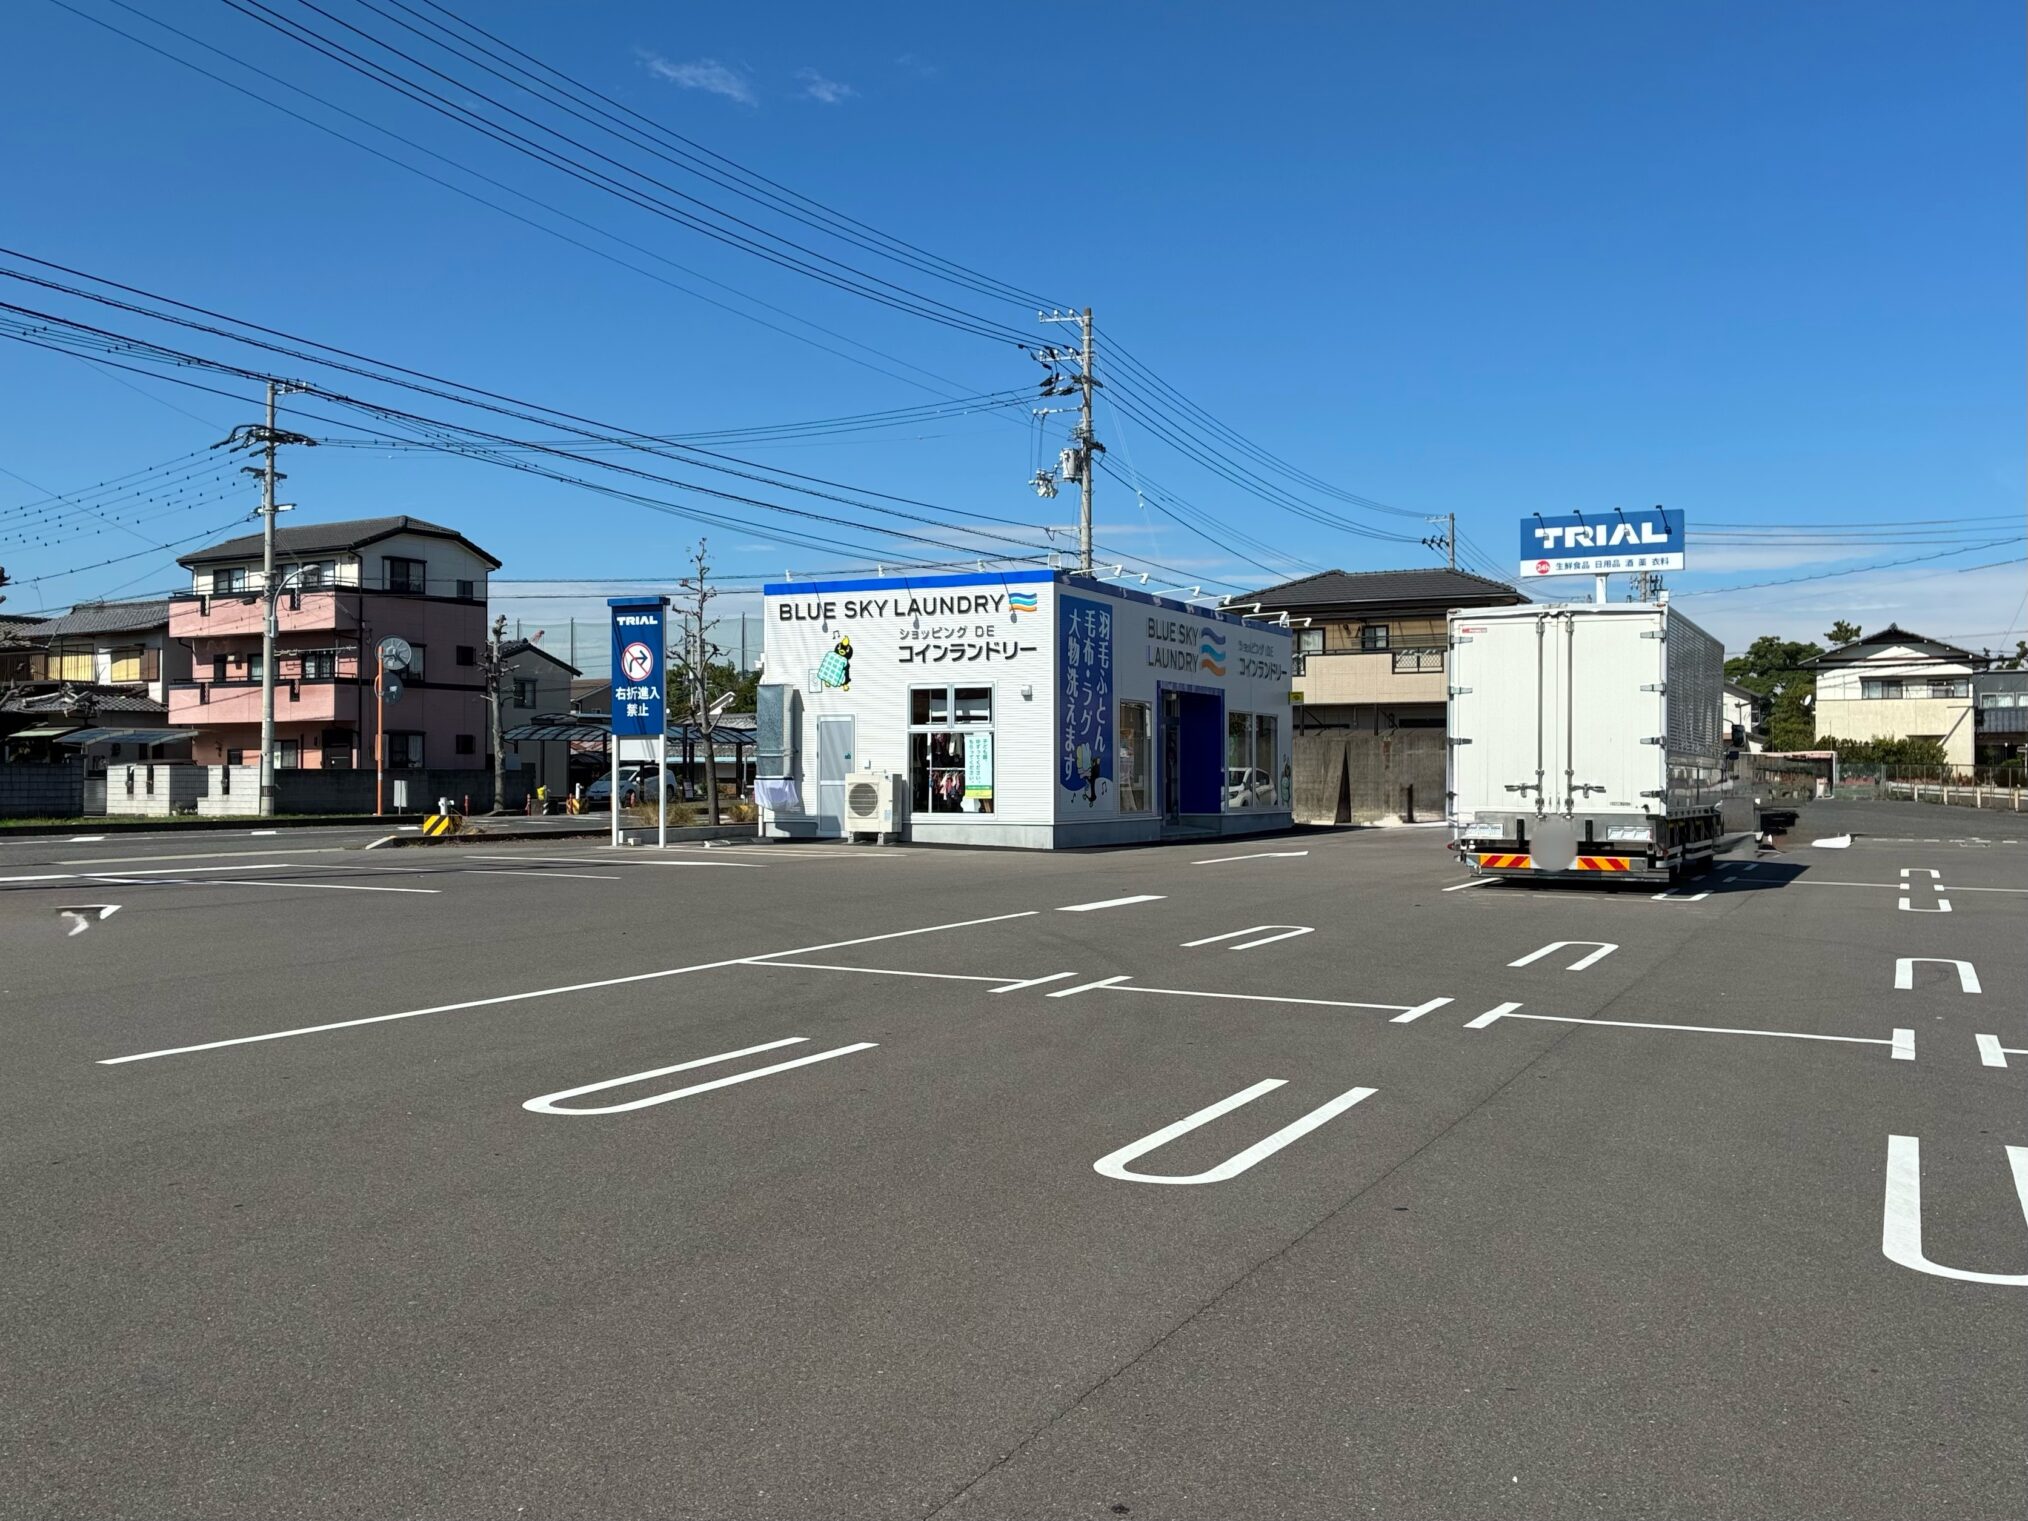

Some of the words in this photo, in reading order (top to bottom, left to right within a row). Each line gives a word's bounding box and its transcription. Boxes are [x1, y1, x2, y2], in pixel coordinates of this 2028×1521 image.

[1535, 522, 1668, 549] TRIAL
[1555, 560, 1591, 571] 生鮮食品
[1595, 558, 1621, 569] 日用品
[1626, 558, 1634, 567] 酒
[1651, 556, 1670, 566] 衣料
[779, 601, 837, 622] BLUE
[844, 599, 888, 618] SKY
[894, 593, 1006, 617] LAUNDRY
[616, 615, 659, 626] TRIAL
[899, 625, 968, 640] ショッピング
[975, 625, 995, 637] DE
[1147, 617, 1176, 643] BLUE
[1178, 624, 1200, 646] SKY
[898, 641, 1037, 663] コインランドリー
[1147, 644, 1200, 674] LAUNDRY
[1081, 609, 1096, 736] 毛布・ラグ
[1094, 609, 1111, 752] 羽毛ふとん
[1239, 657, 1287, 681] コインランドリー
[615, 687, 660, 700] 右折進入
[1064, 608, 1081, 781] 大物洗えます
[626, 703, 649, 717] 禁止
